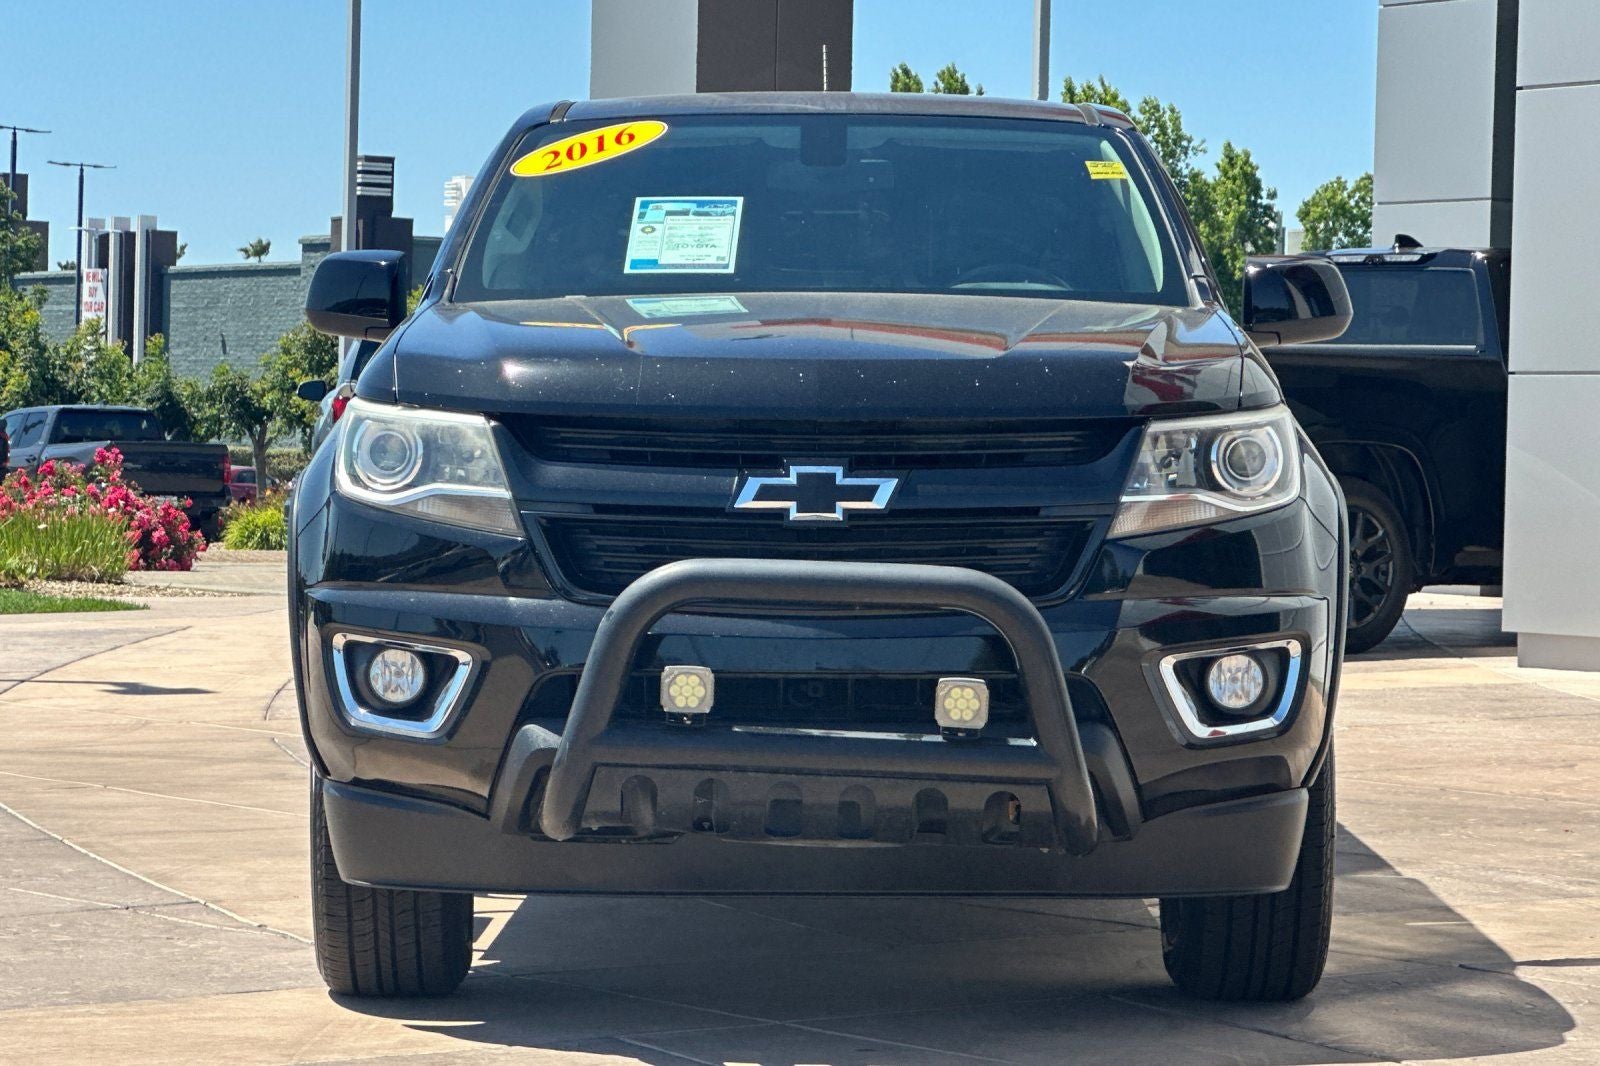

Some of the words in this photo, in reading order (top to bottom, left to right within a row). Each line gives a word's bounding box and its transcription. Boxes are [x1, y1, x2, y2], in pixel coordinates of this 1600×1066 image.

[541, 125, 636, 171] 2016
[88, 286, 98, 298] BUY
[94, 301, 105, 312] CAR
